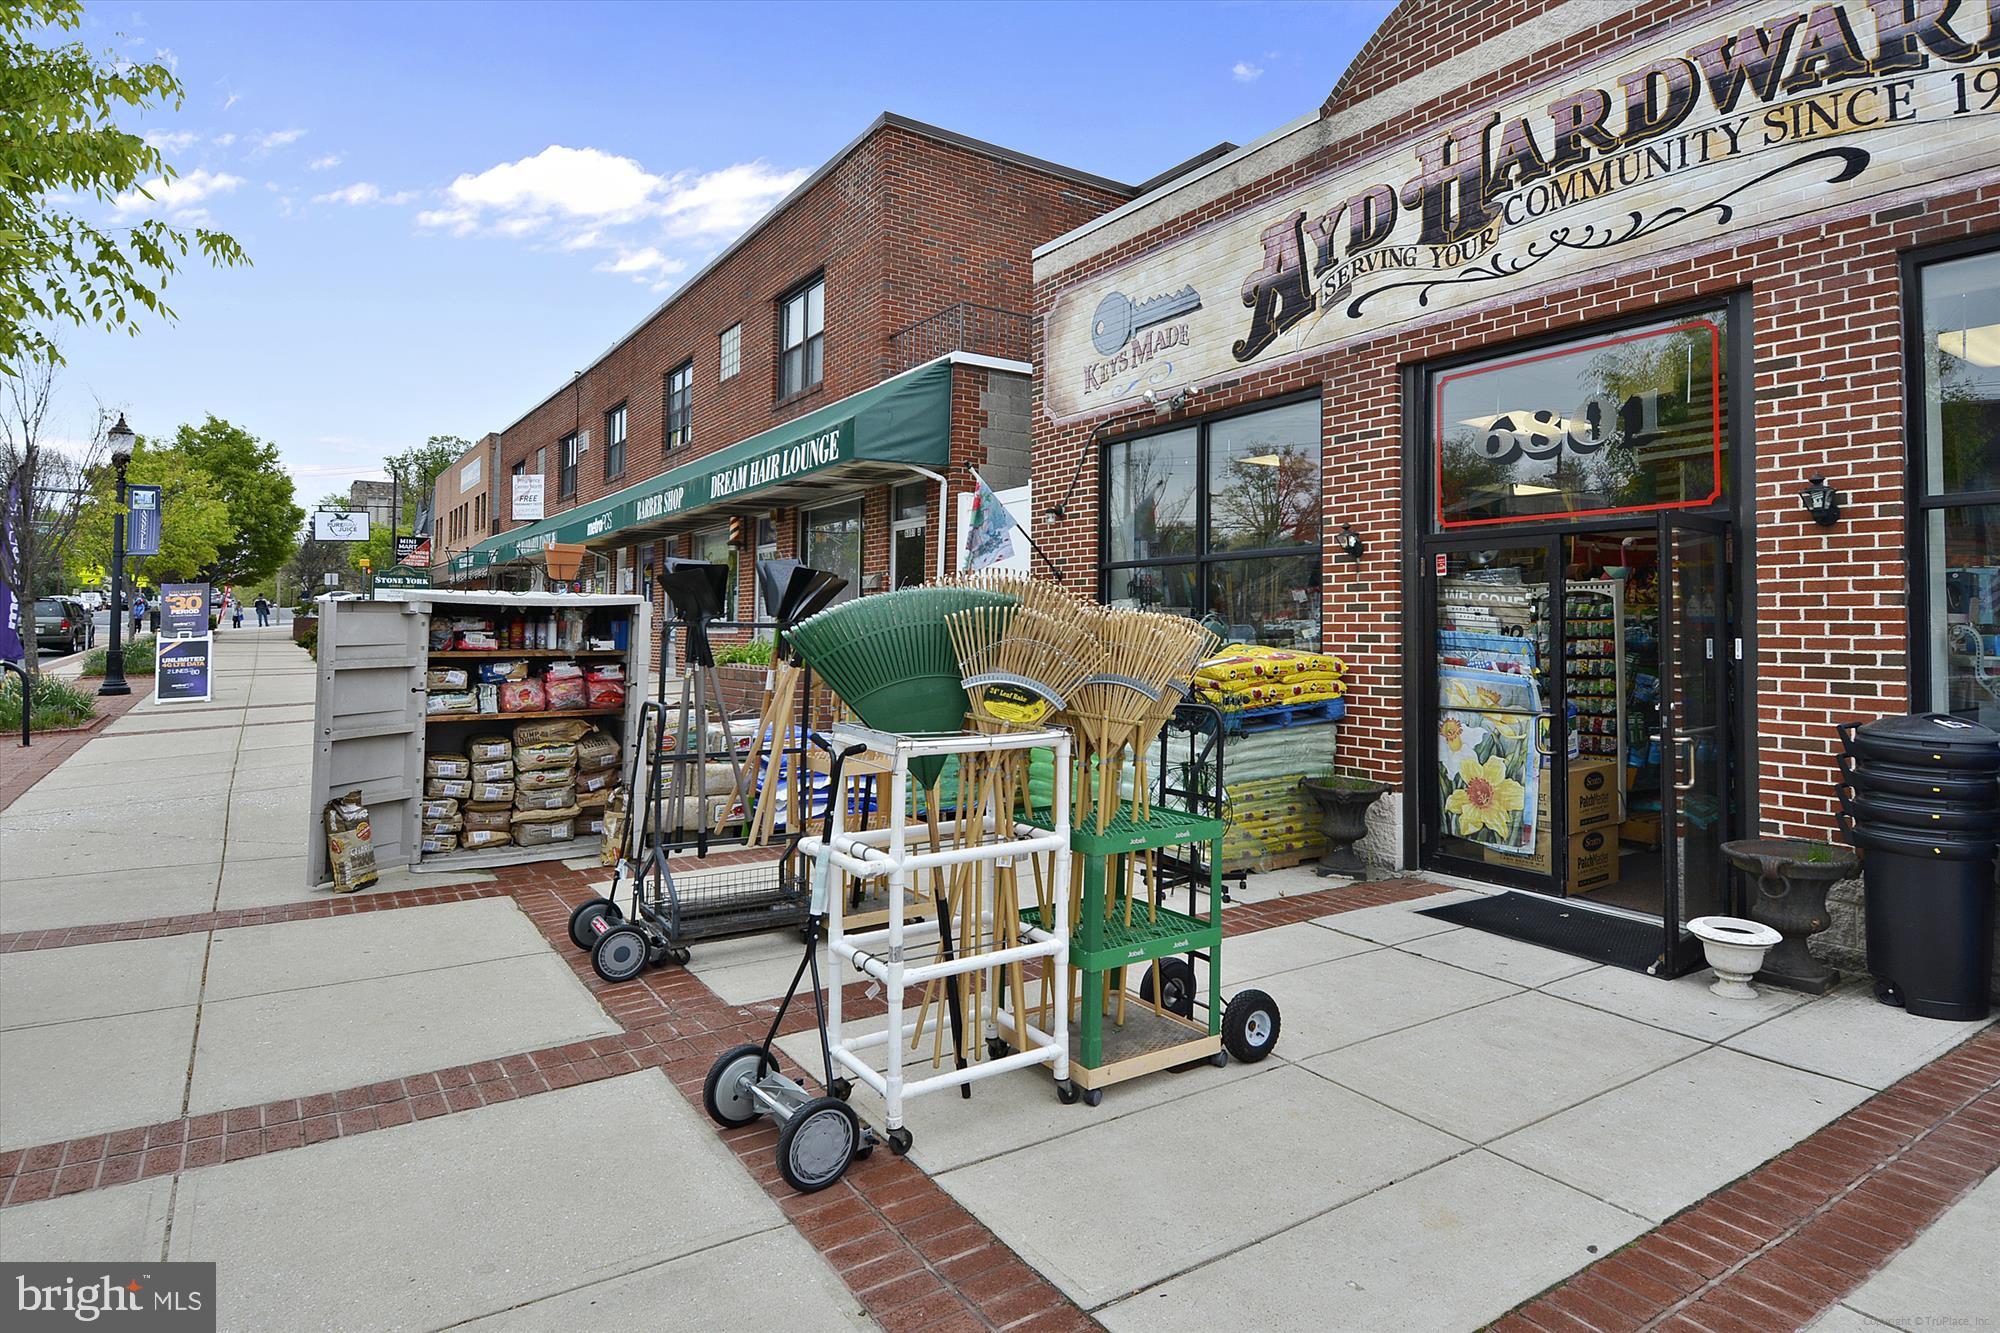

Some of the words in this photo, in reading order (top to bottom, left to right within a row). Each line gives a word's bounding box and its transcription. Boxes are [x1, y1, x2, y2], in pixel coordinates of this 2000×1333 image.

[1232, 184, 1397, 362] AYD
[1400, 0, 2000, 248] HARDWAR
[1324, 245, 1417, 299] SERVING
[1429, 226, 1497, 269] YOUR
[1503, 115, 1749, 225] COMMUNITY
[1764, 80, 1917, 146] SINCE
[1084, 351, 1129, 395] KEYS
[1131, 323, 1190, 370] MADE
[1473, 388, 1668, 465] 6801
[710, 466, 748, 499] DREAM
[749, 453, 780, 487] HAIR
[781, 430, 840, 477] LOUNGE
[519, 494, 539, 502] FREE
[636, 491, 664, 521] BARBER
[664, 487, 684, 515] SHOP
[586, 511, 613, 537] metroPCS
[374, 576, 404, 585] STONE
[405, 577, 429, 585] YORK
[1000, 689, 1014, 699] Leaf
[1013, 691, 1028, 702] Rake
